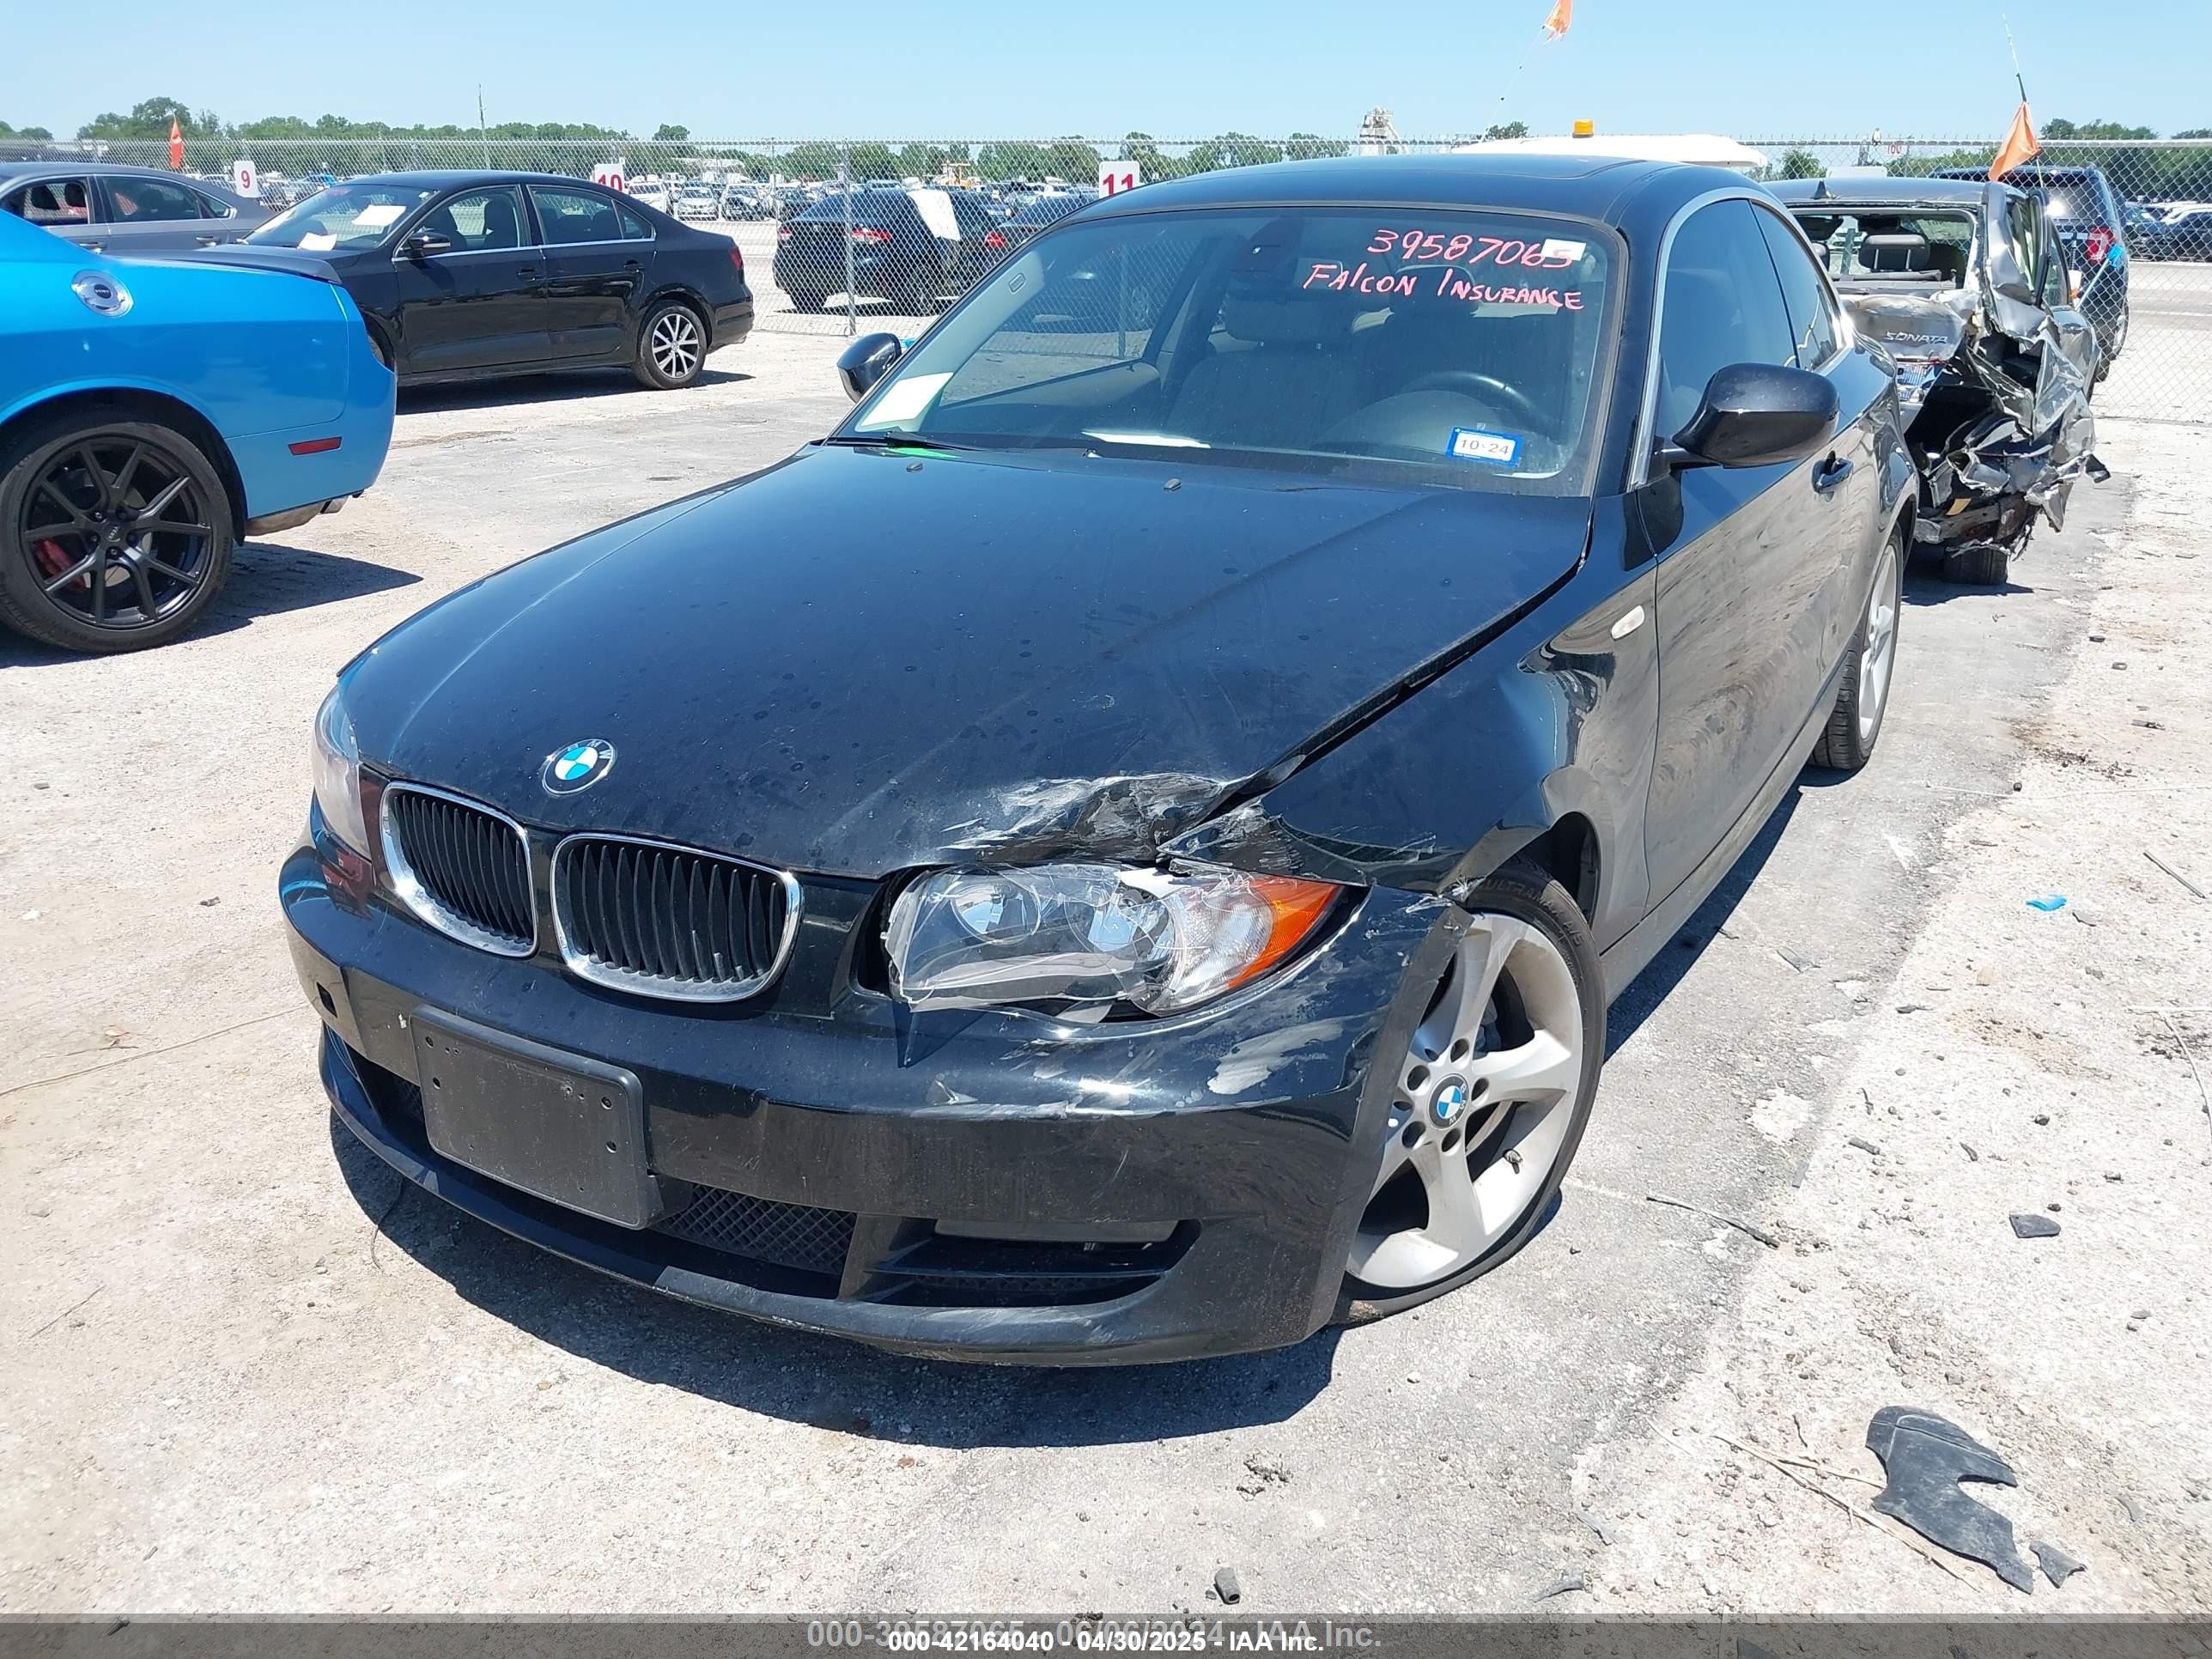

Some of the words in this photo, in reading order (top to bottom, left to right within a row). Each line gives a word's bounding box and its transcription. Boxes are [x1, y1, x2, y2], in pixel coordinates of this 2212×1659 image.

[240, 170, 251, 189] 9
[1103, 173, 1133, 196] 11
[1366, 228, 1572, 269] 39587065
[1437, 268, 1585, 311] INSURANCE
[1884, 331, 1949, 343] SONATA
